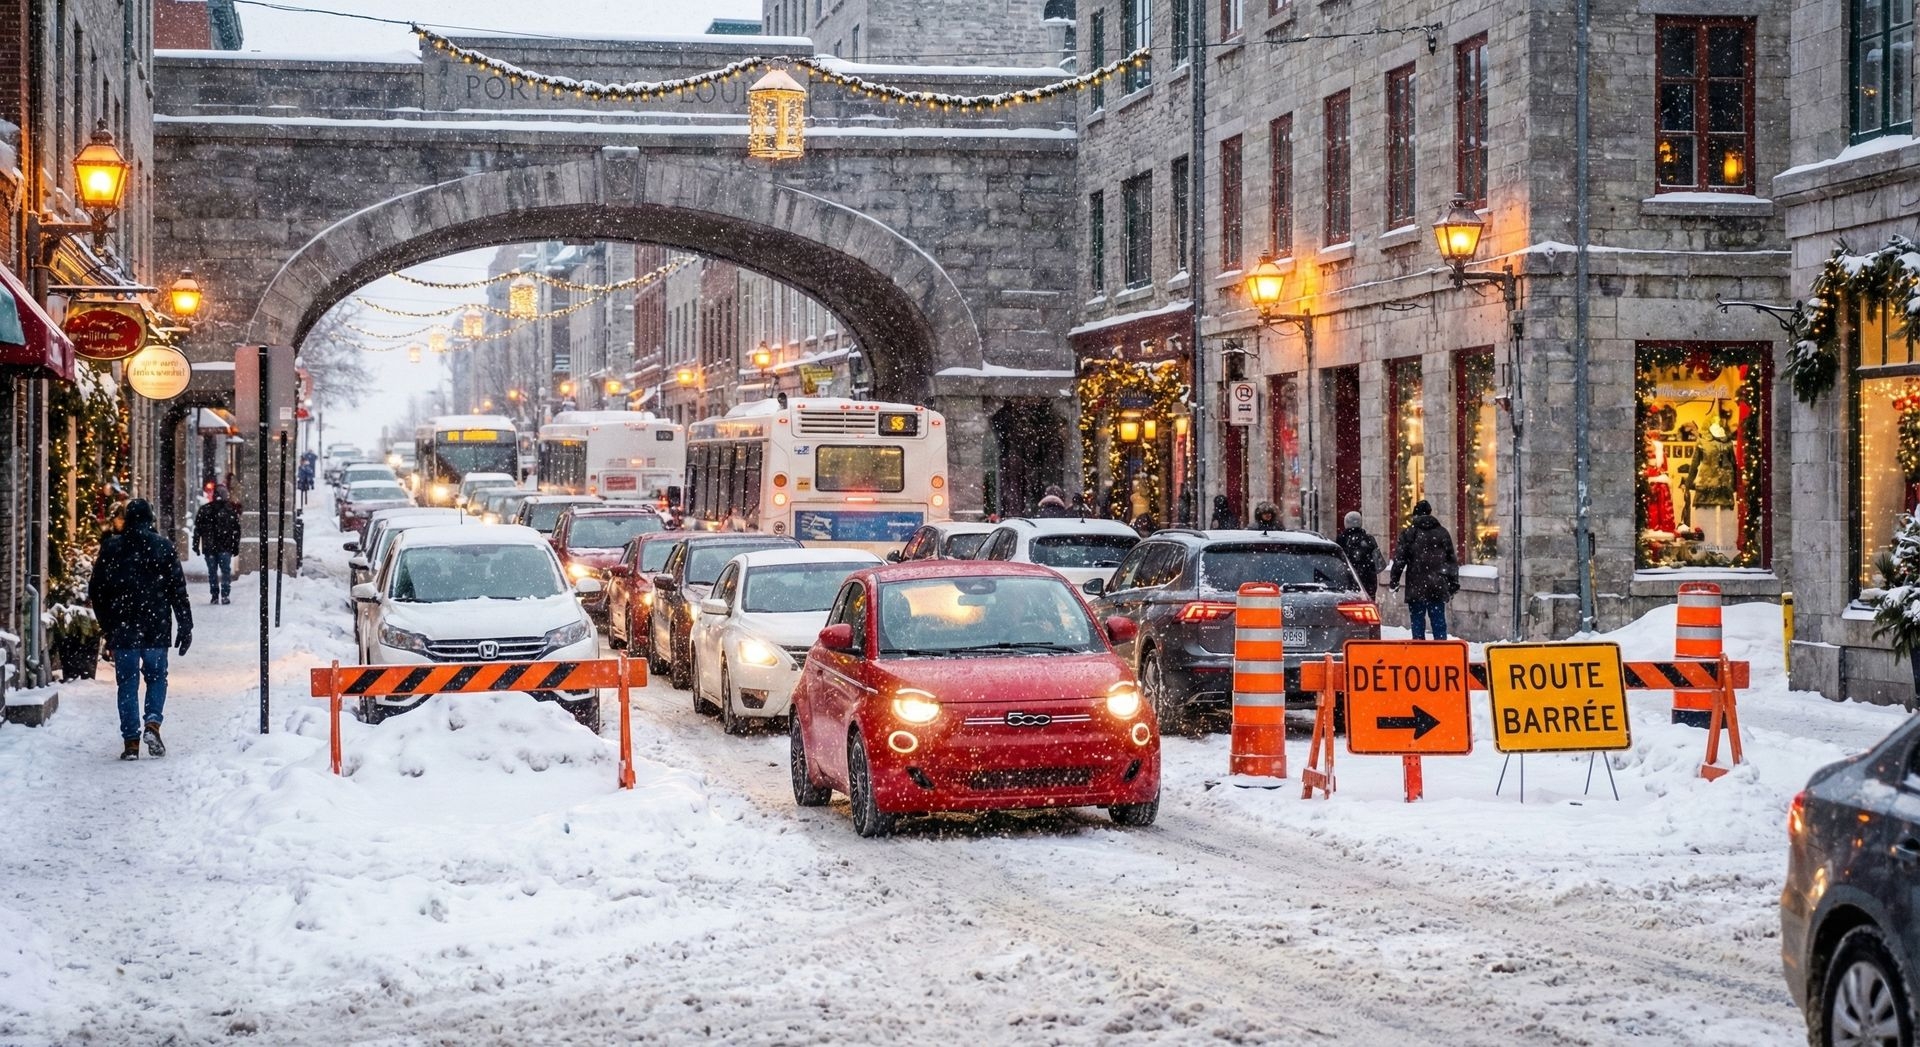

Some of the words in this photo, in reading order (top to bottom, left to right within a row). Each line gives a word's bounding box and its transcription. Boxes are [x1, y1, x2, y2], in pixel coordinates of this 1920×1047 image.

[466, 74, 565, 101] POR
[680, 80, 755, 105] LOUI
[1353, 659, 1461, 692] DÉTOUR
[1509, 661, 1604, 690] ROUTE
[1007, 712, 1051, 726] 500
[1503, 699, 1619, 734] BARRÉE
